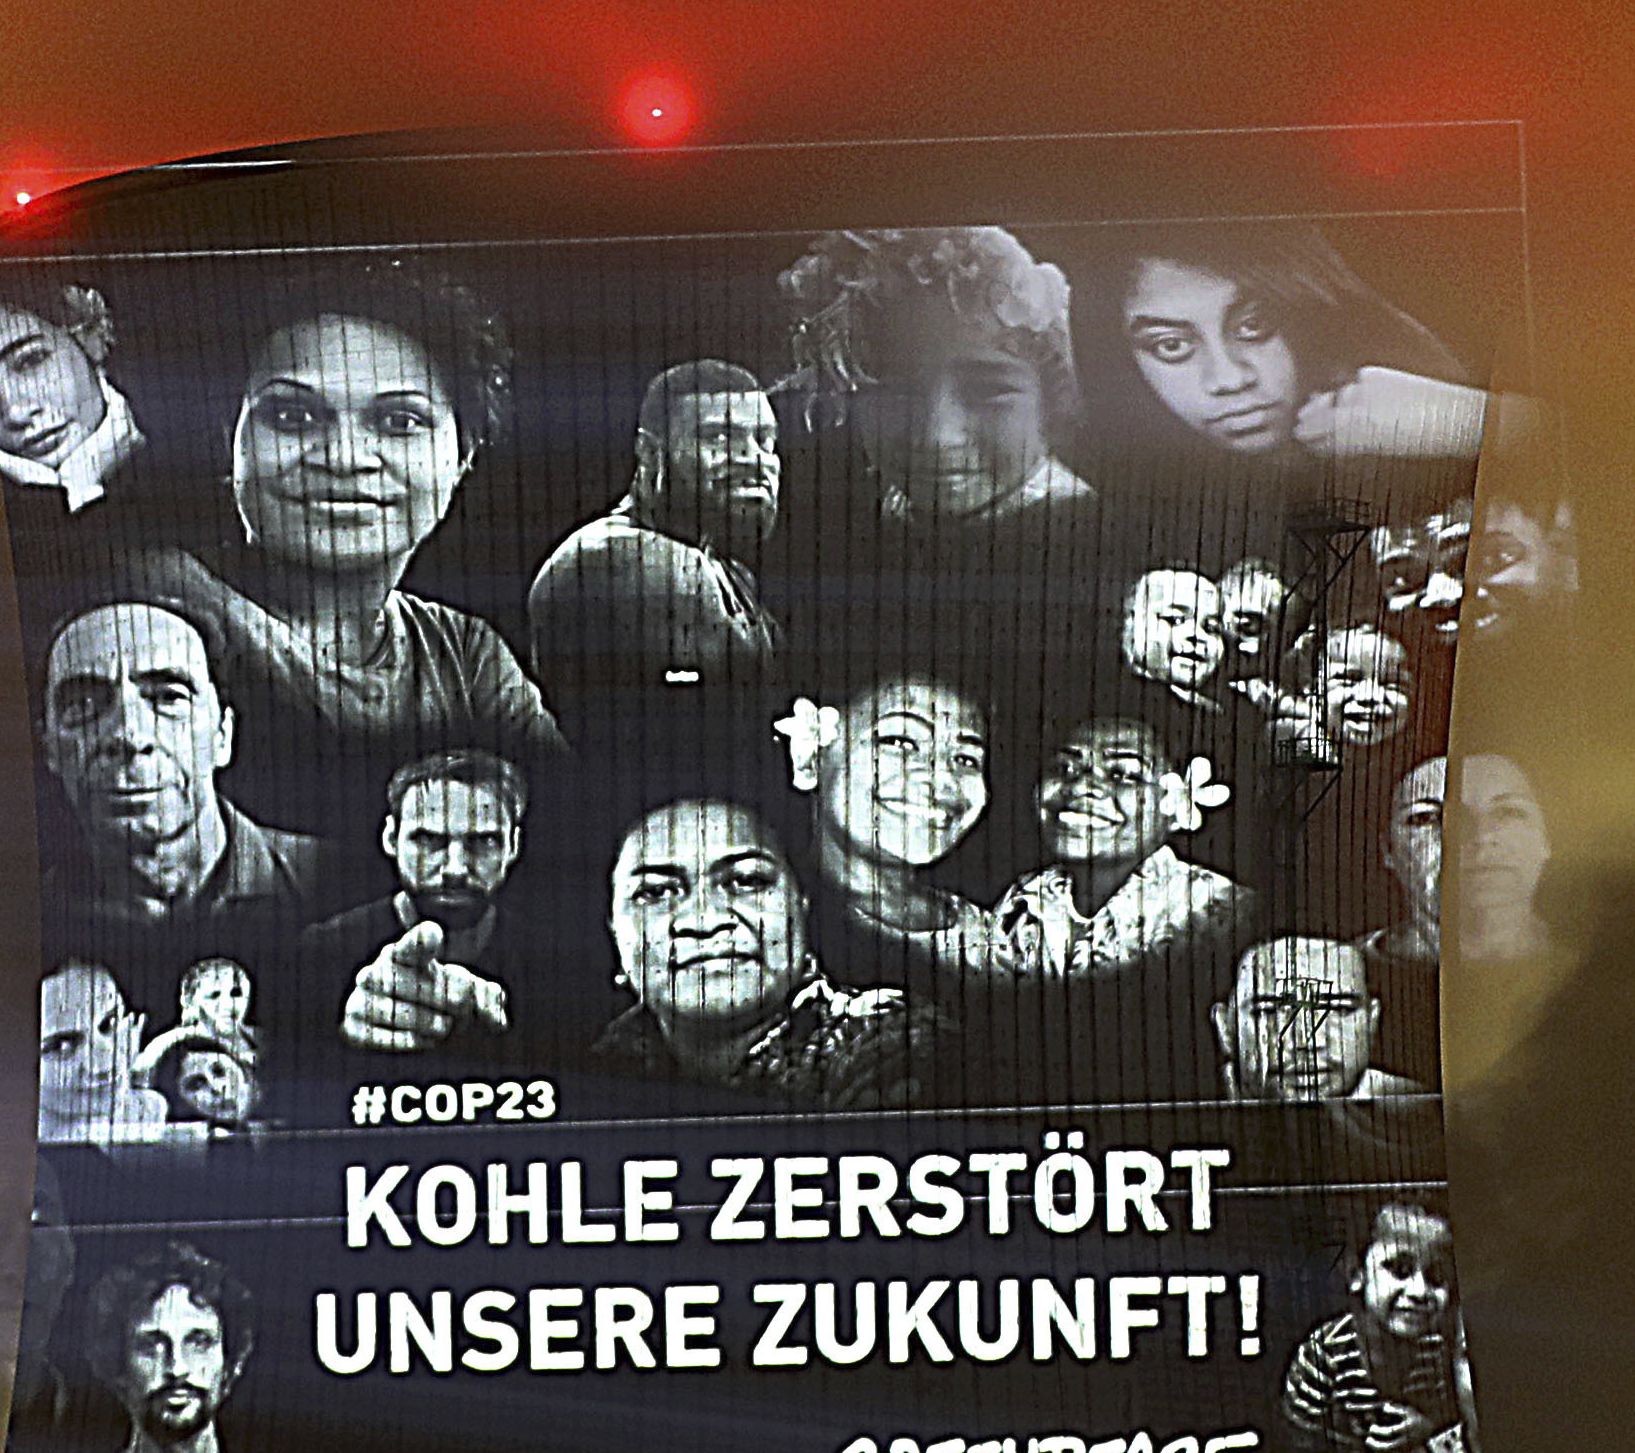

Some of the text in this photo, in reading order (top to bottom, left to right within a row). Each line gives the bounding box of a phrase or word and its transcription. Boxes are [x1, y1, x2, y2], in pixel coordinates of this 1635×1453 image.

[351, 1080, 556, 1125] #COP23
[345, 1130, 1231, 1249] KOHLE ZERSTÖRT
[315, 1274, 1262, 1375] UNSERE ZUKUNFT!
